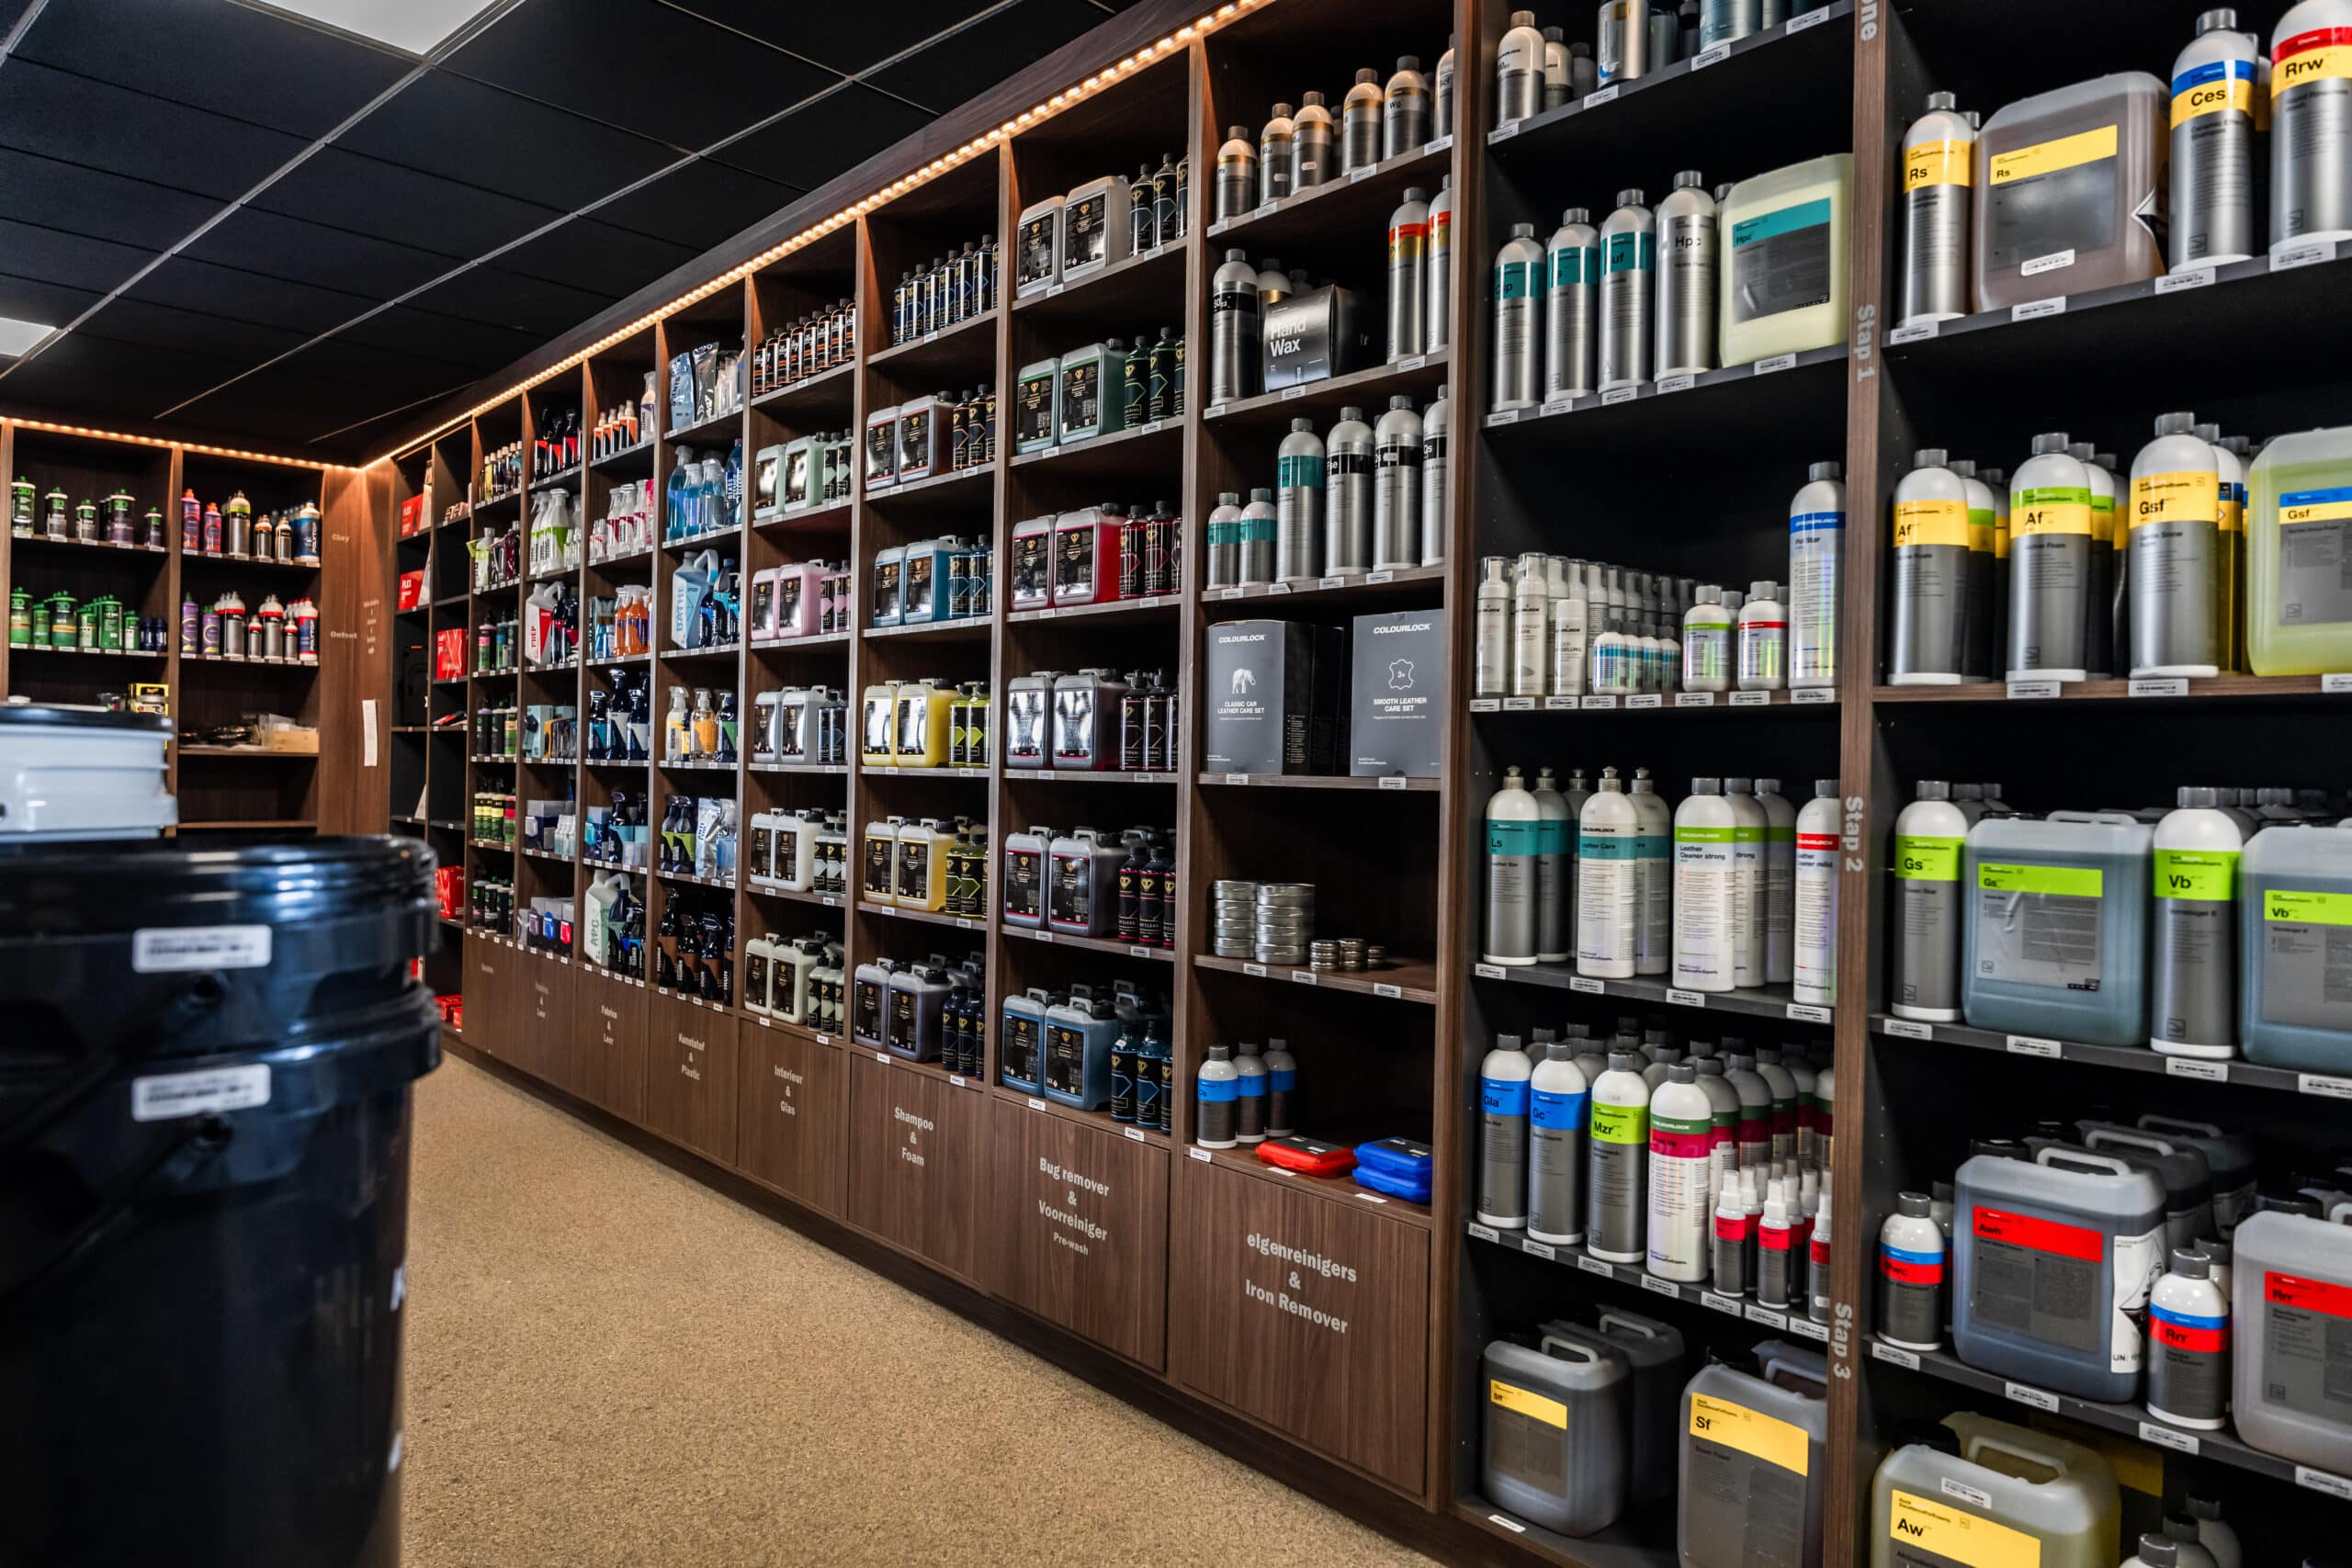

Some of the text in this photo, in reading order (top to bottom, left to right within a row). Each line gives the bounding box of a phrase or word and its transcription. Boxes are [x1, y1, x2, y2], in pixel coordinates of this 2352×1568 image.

[2286, 58, 2324, 78] Rrw
[2191, 89, 2226, 107] Ces
[1909, 168, 1928, 182] Rs
[1996, 169, 2010, 178] Rs
[1270, 320, 1306, 341] Hand
[1270, 337, 1301, 357] Wax
[1853, 304, 1875, 383] Stap 1
[2139, 499, 2165, 515] Gsf
[2288, 509, 2310, 520] Gsf
[2025, 511, 2043, 525] Af
[1898, 524, 1912, 537] Af
[1374, 623, 1430, 634] COLOURLOCK
[1218, 634, 1265, 643] COLOURLOCK
[1397, 671, 1406, 679] 3+
[1842, 795, 1863, 872] Stap 2
[1491, 838, 1502, 848] Ls
[1679, 852, 1725, 862] Cleaner strong
[1904, 857, 1924, 871] Gs
[1984, 877, 1997, 887] Gs
[2168, 874, 2191, 889] Vb
[2272, 908, 2290, 919] Vb
[678, 1032, 706, 1052] Kunststof
[681, 1064, 701, 1080] Plastic
[775, 1066, 803, 1085] Interieur
[786, 1085, 791, 1097] &
[780, 1100, 796, 1116] Glas
[1484, 1095, 1499, 1108] Gla
[894, 1106, 934, 1131] Shampoo
[1533, 1106, 1545, 1120] Gc
[1594, 1121, 1613, 1134] Mzr
[910, 1131, 917, 1145] &
[901, 1146, 924, 1168] Foam
[1039, 1157, 1110, 1197] Bug remover
[1068, 1190, 1078, 1206] &
[1038, 1199, 1108, 1241] Voorreiniger
[1054, 1231, 1089, 1256] Pre-wash
[1289, 1270, 1301, 1291] &
[1246, 1279, 1348, 1334] Iron Remover
[1830, 1302, 1852, 1380] Stap 3
[2164, 1327, 2186, 1342] Rrr
[1695, 1416, 1711, 1430] Sf
[1897, 1517, 1925, 1537] Aw
